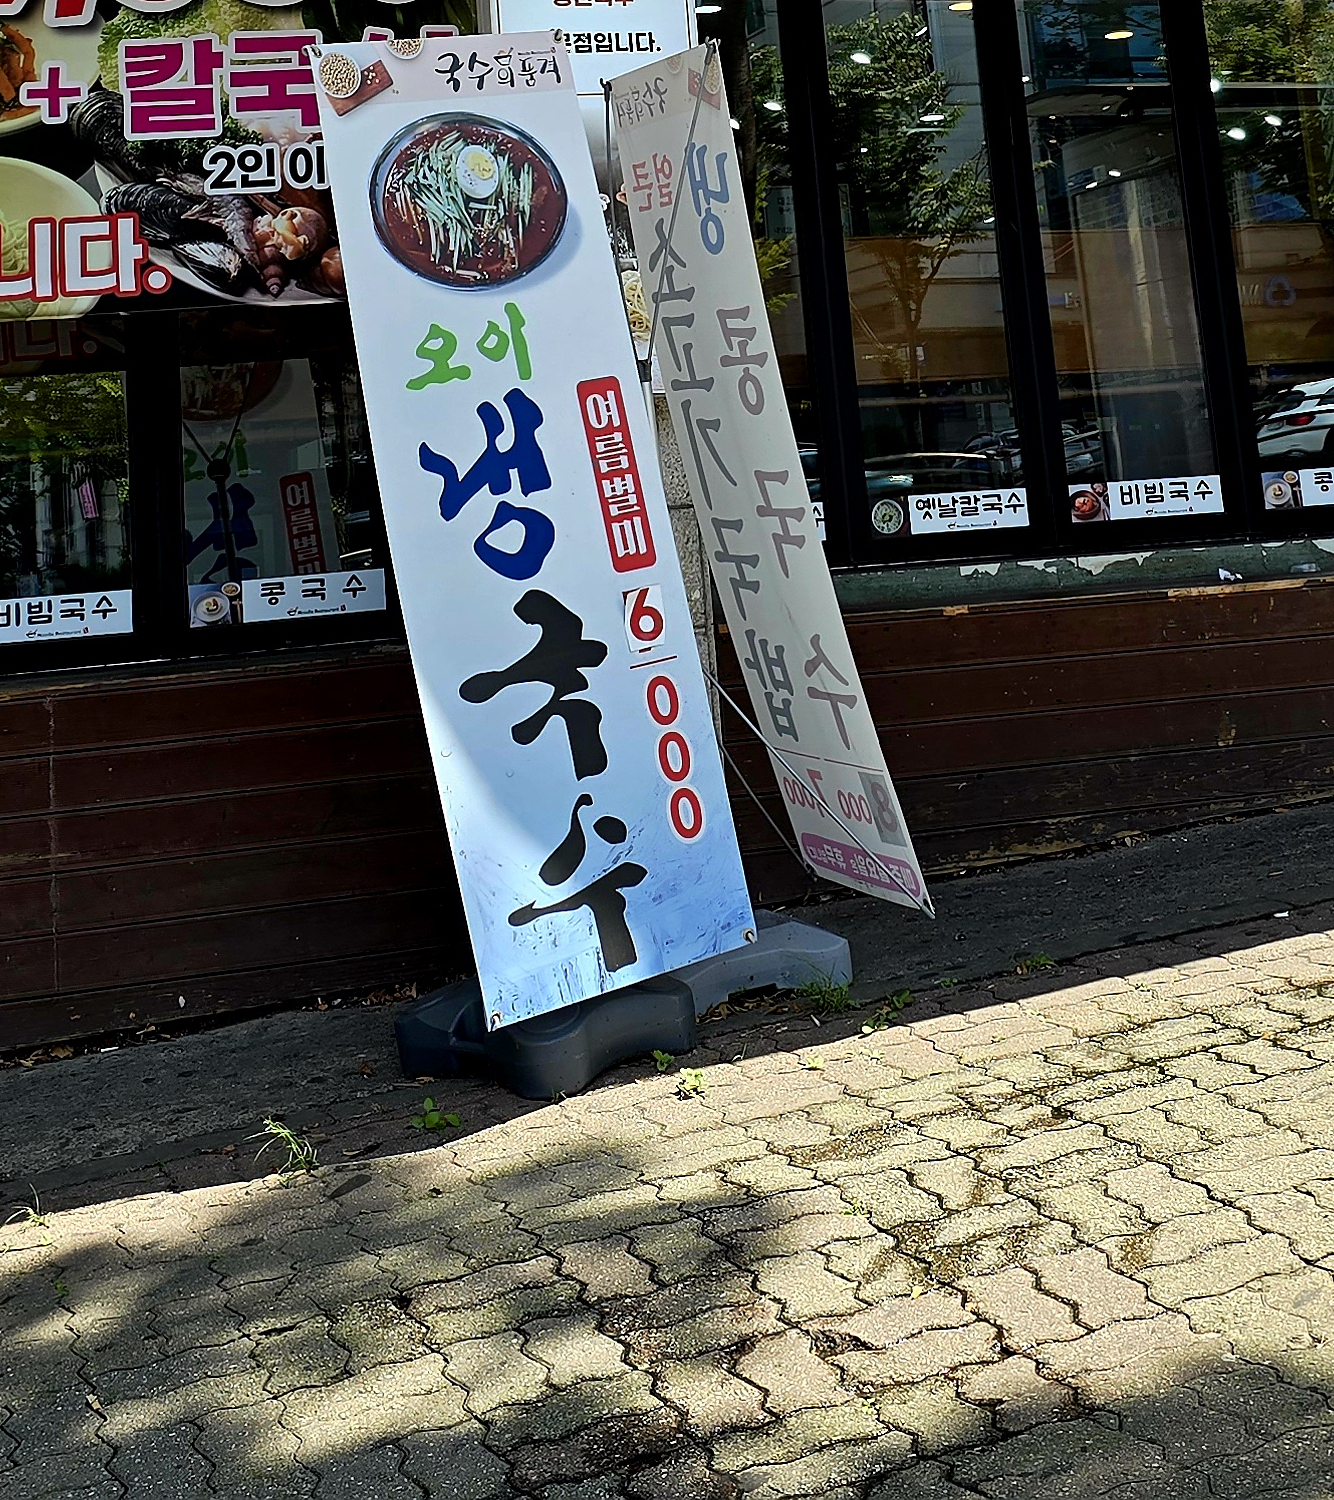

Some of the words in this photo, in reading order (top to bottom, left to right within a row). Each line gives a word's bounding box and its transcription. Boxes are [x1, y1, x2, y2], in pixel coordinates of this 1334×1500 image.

[551, 30, 663, 54] 점입니다.
[204, 142, 282, 195] 2인
[405, 301, 533, 390] 오이
[915, 489, 1026, 521] 옛날칼국수
[1119, 479, 1215, 506] 비빔국수
